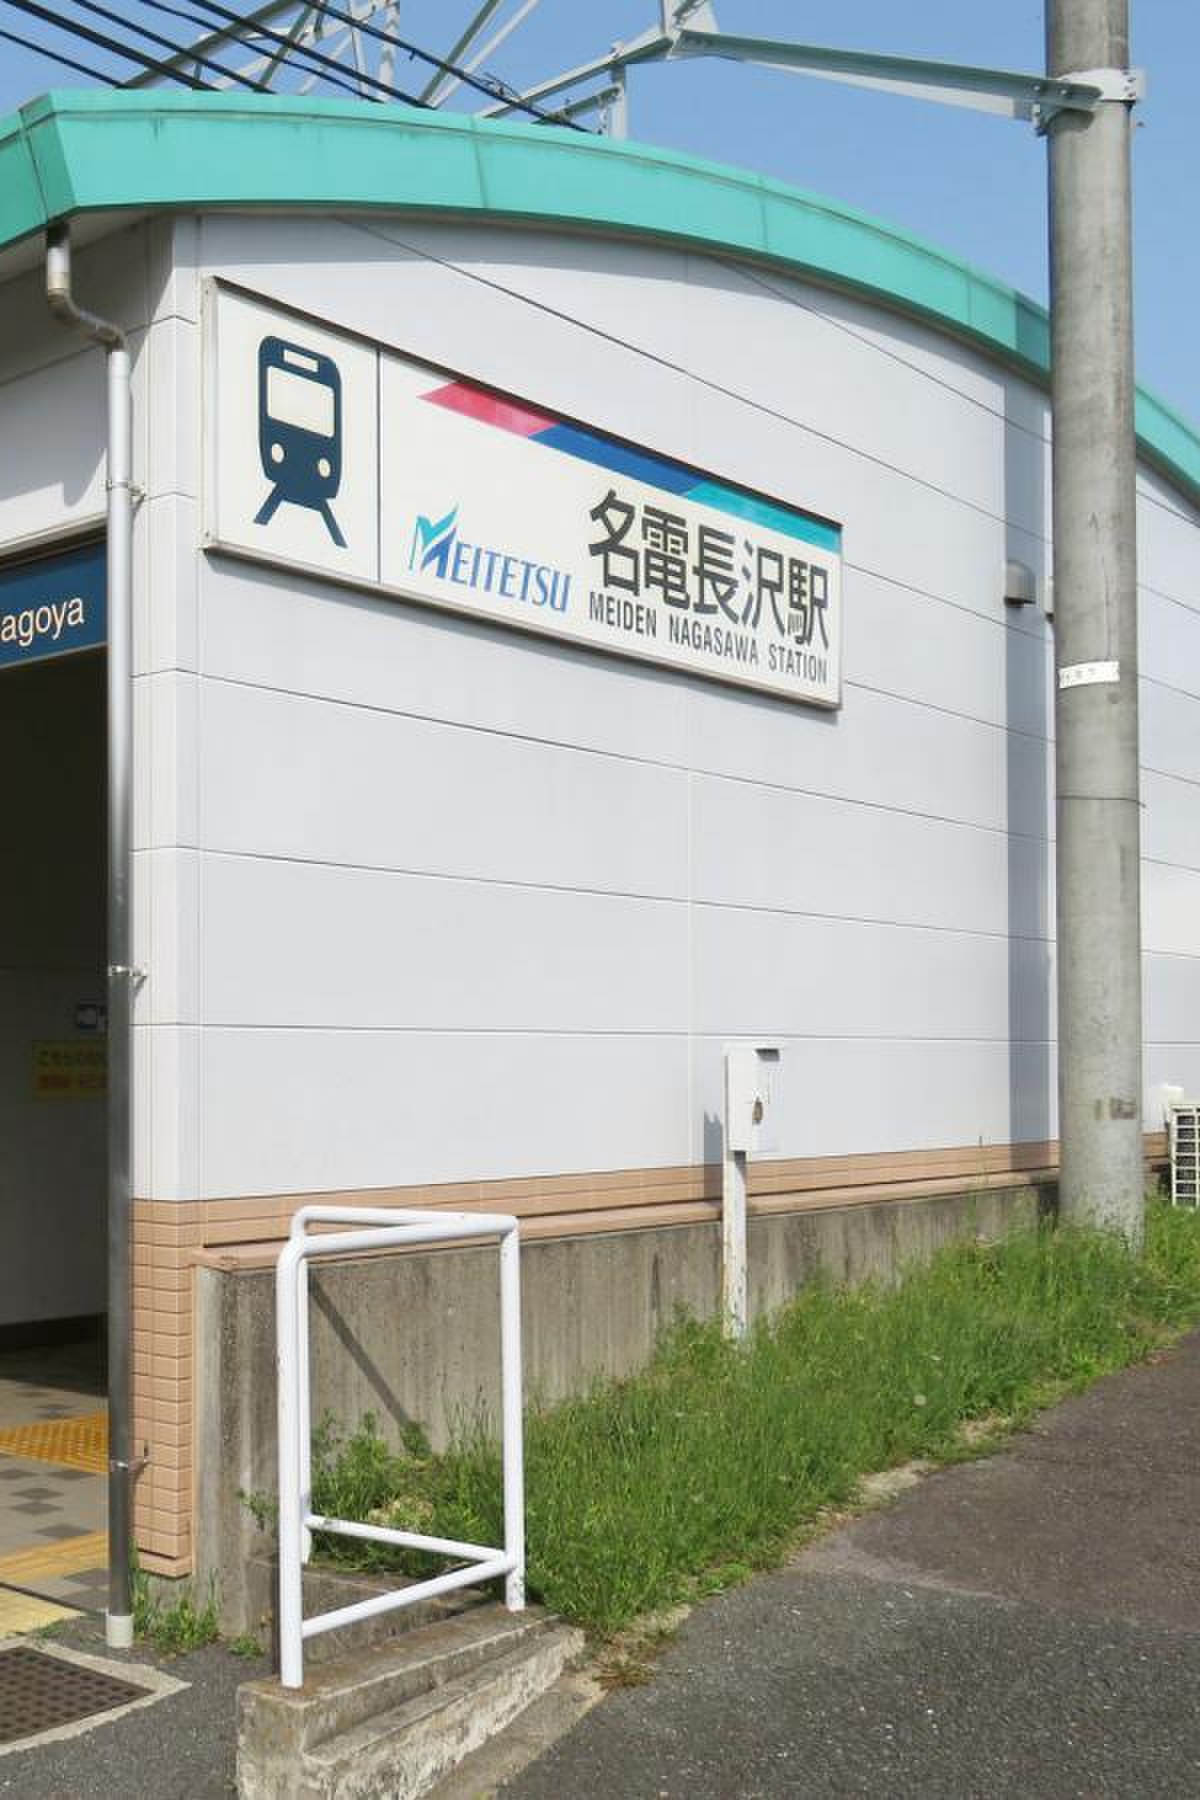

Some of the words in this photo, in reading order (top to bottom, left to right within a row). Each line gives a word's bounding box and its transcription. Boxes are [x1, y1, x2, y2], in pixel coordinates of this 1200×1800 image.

[408, 500, 572, 612] MEITETSU
[588, 489, 829, 648] 名電長沢駅
[589, 591, 657, 638] MEIDEN
[669, 614, 759, 665] NAGASAWA
[768, 643, 827, 684] STATION
